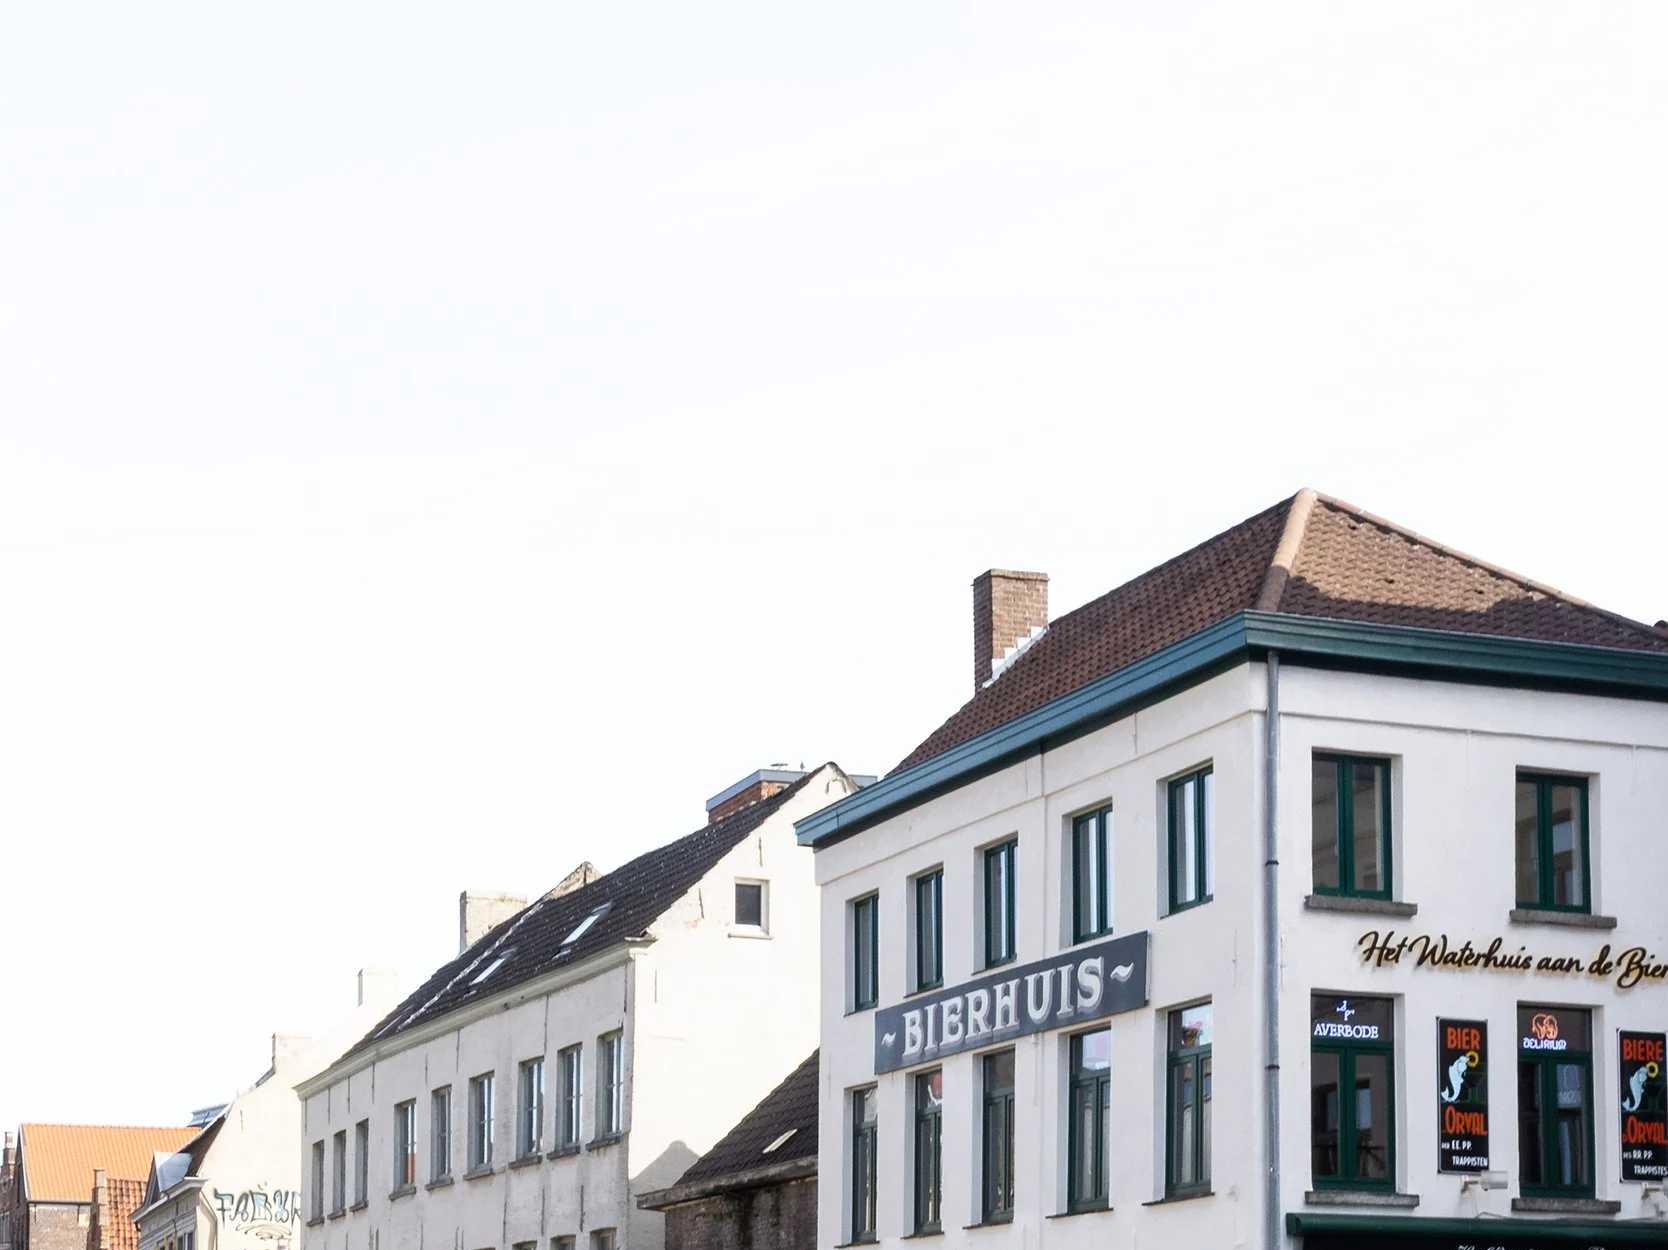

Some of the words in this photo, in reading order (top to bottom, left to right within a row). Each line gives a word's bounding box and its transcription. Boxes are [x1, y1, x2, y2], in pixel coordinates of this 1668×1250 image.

[1358, 930, 1408, 967] Het
[1408, 934, 1533, 970] Waterhuis
[1537, 956, 1585, 973] aan
[1588, 944, 1613, 976] de
[902, 956, 1104, 1057] BIERHUIS
[1313, 1022, 1379, 1039] AVERBODE
[1446, 1027, 1481, 1050] BIER
[1523, 1037, 1567, 1050] DELIRIUM
[1622, 1038, 1664, 1062] BIERE
[1445, 1106, 1488, 1136] ORVAL
[1452, 1156, 1488, 1167] TRAPPISTEN
